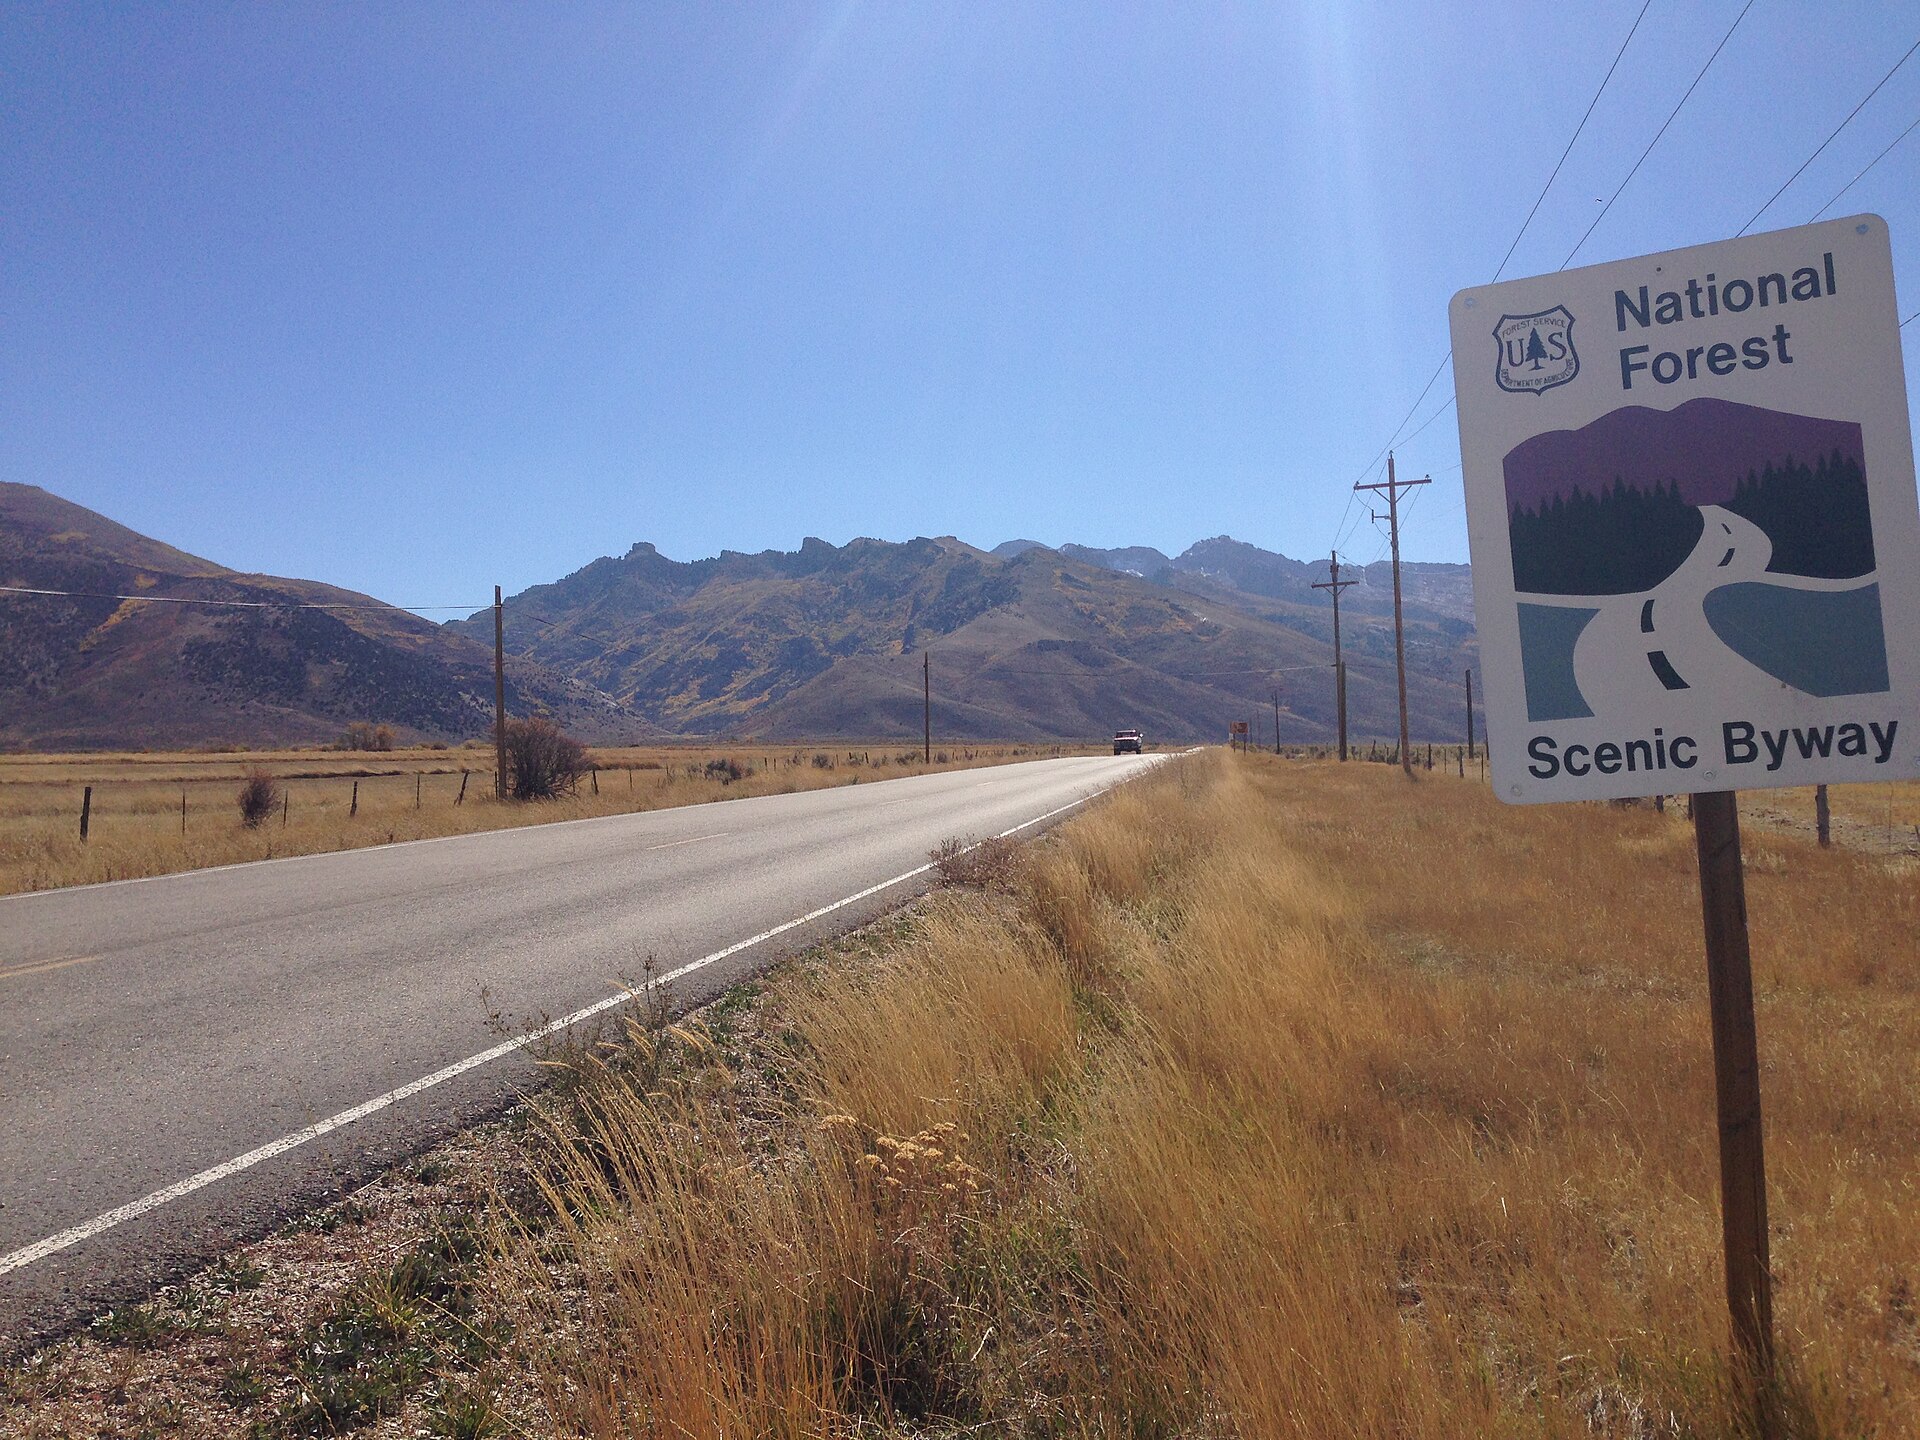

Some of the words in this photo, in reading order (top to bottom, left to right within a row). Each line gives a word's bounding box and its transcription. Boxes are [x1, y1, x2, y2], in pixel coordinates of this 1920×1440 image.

[1614, 253, 1836, 331] National
[1502, 320, 1531, 338] FOREST
[1533, 318, 1566, 328] SERVICE
[1620, 324, 1793, 389] Forest
[1527, 728, 1698, 779] Scenic
[1722, 719, 1899, 771] Byway
